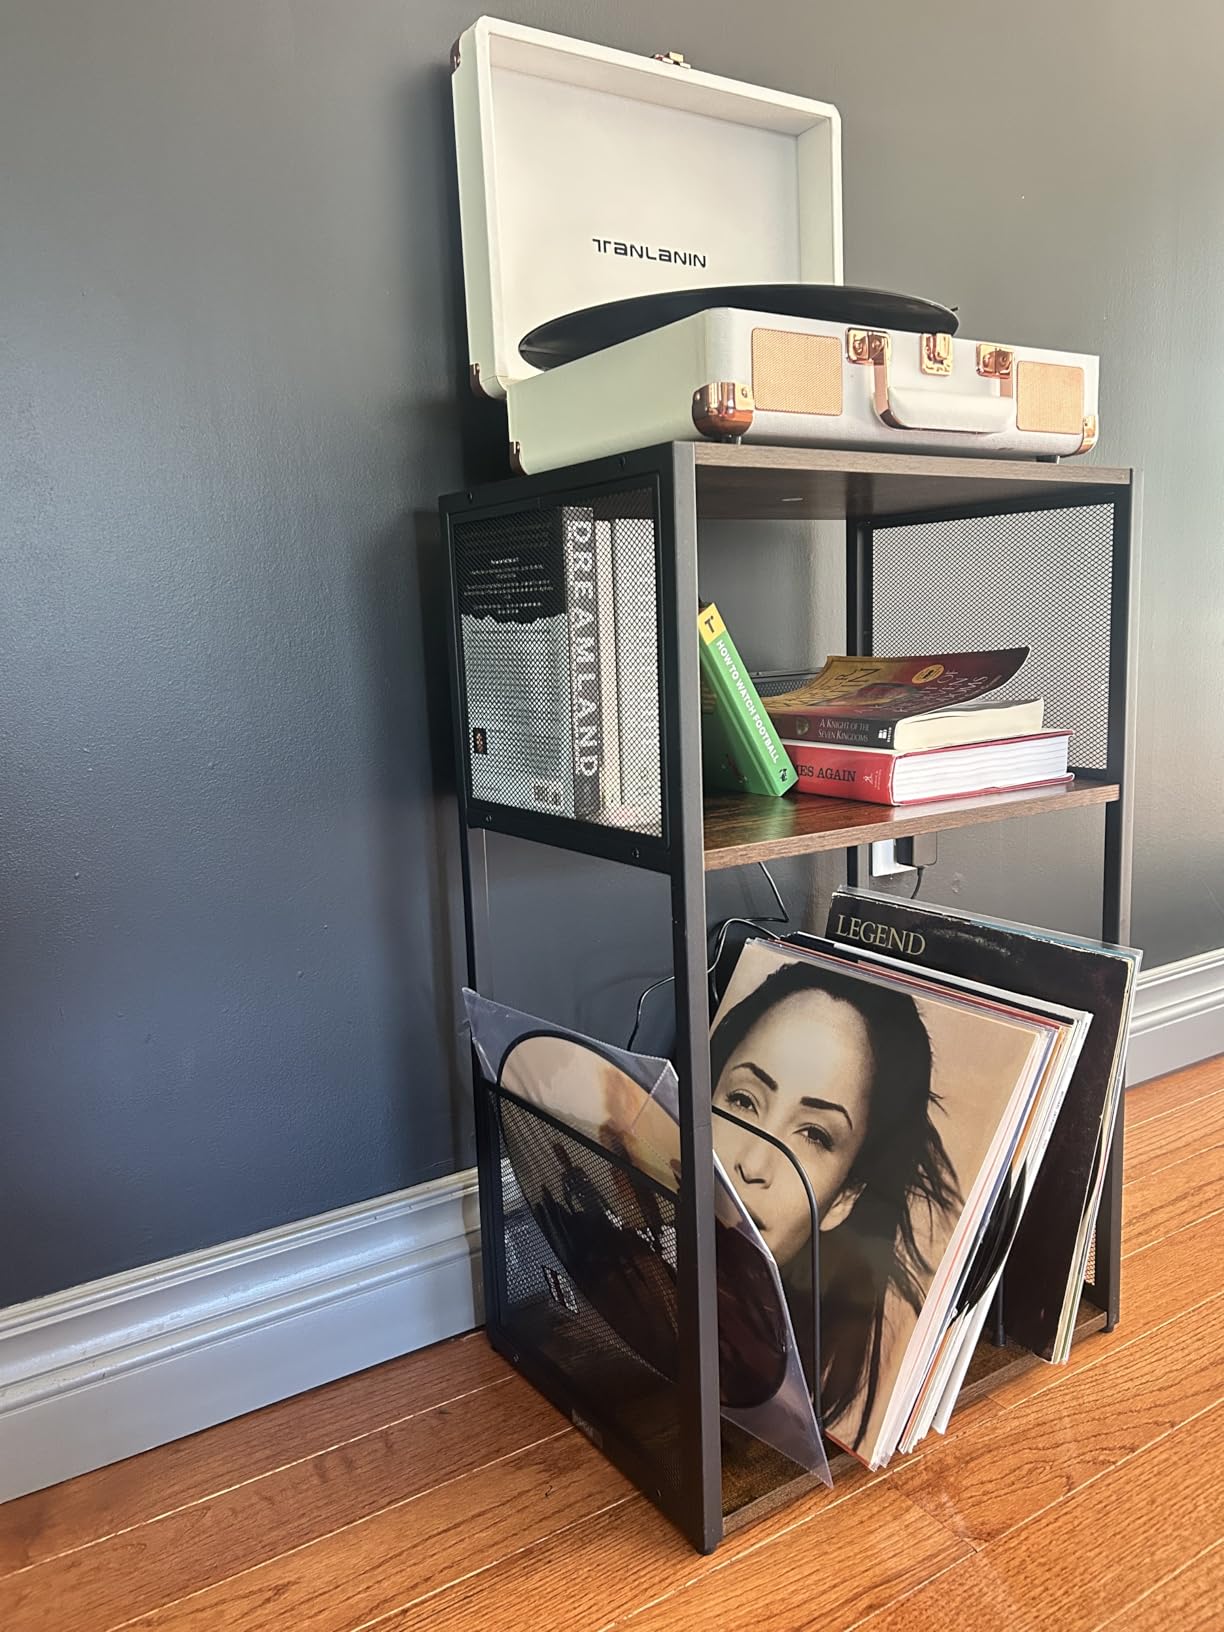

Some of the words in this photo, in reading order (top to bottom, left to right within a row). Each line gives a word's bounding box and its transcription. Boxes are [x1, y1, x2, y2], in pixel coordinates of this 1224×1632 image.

[574, 520, 598, 777] DREAMLAND
[716, 639, 733, 666] HOW
[728, 664, 740, 681] TO
[736, 678, 757, 716] WATCH
[752, 714, 780, 764] FOOTBALL
[816, 767, 857, 782] AGAIN
[836, 914, 926, 955] LEGEND
